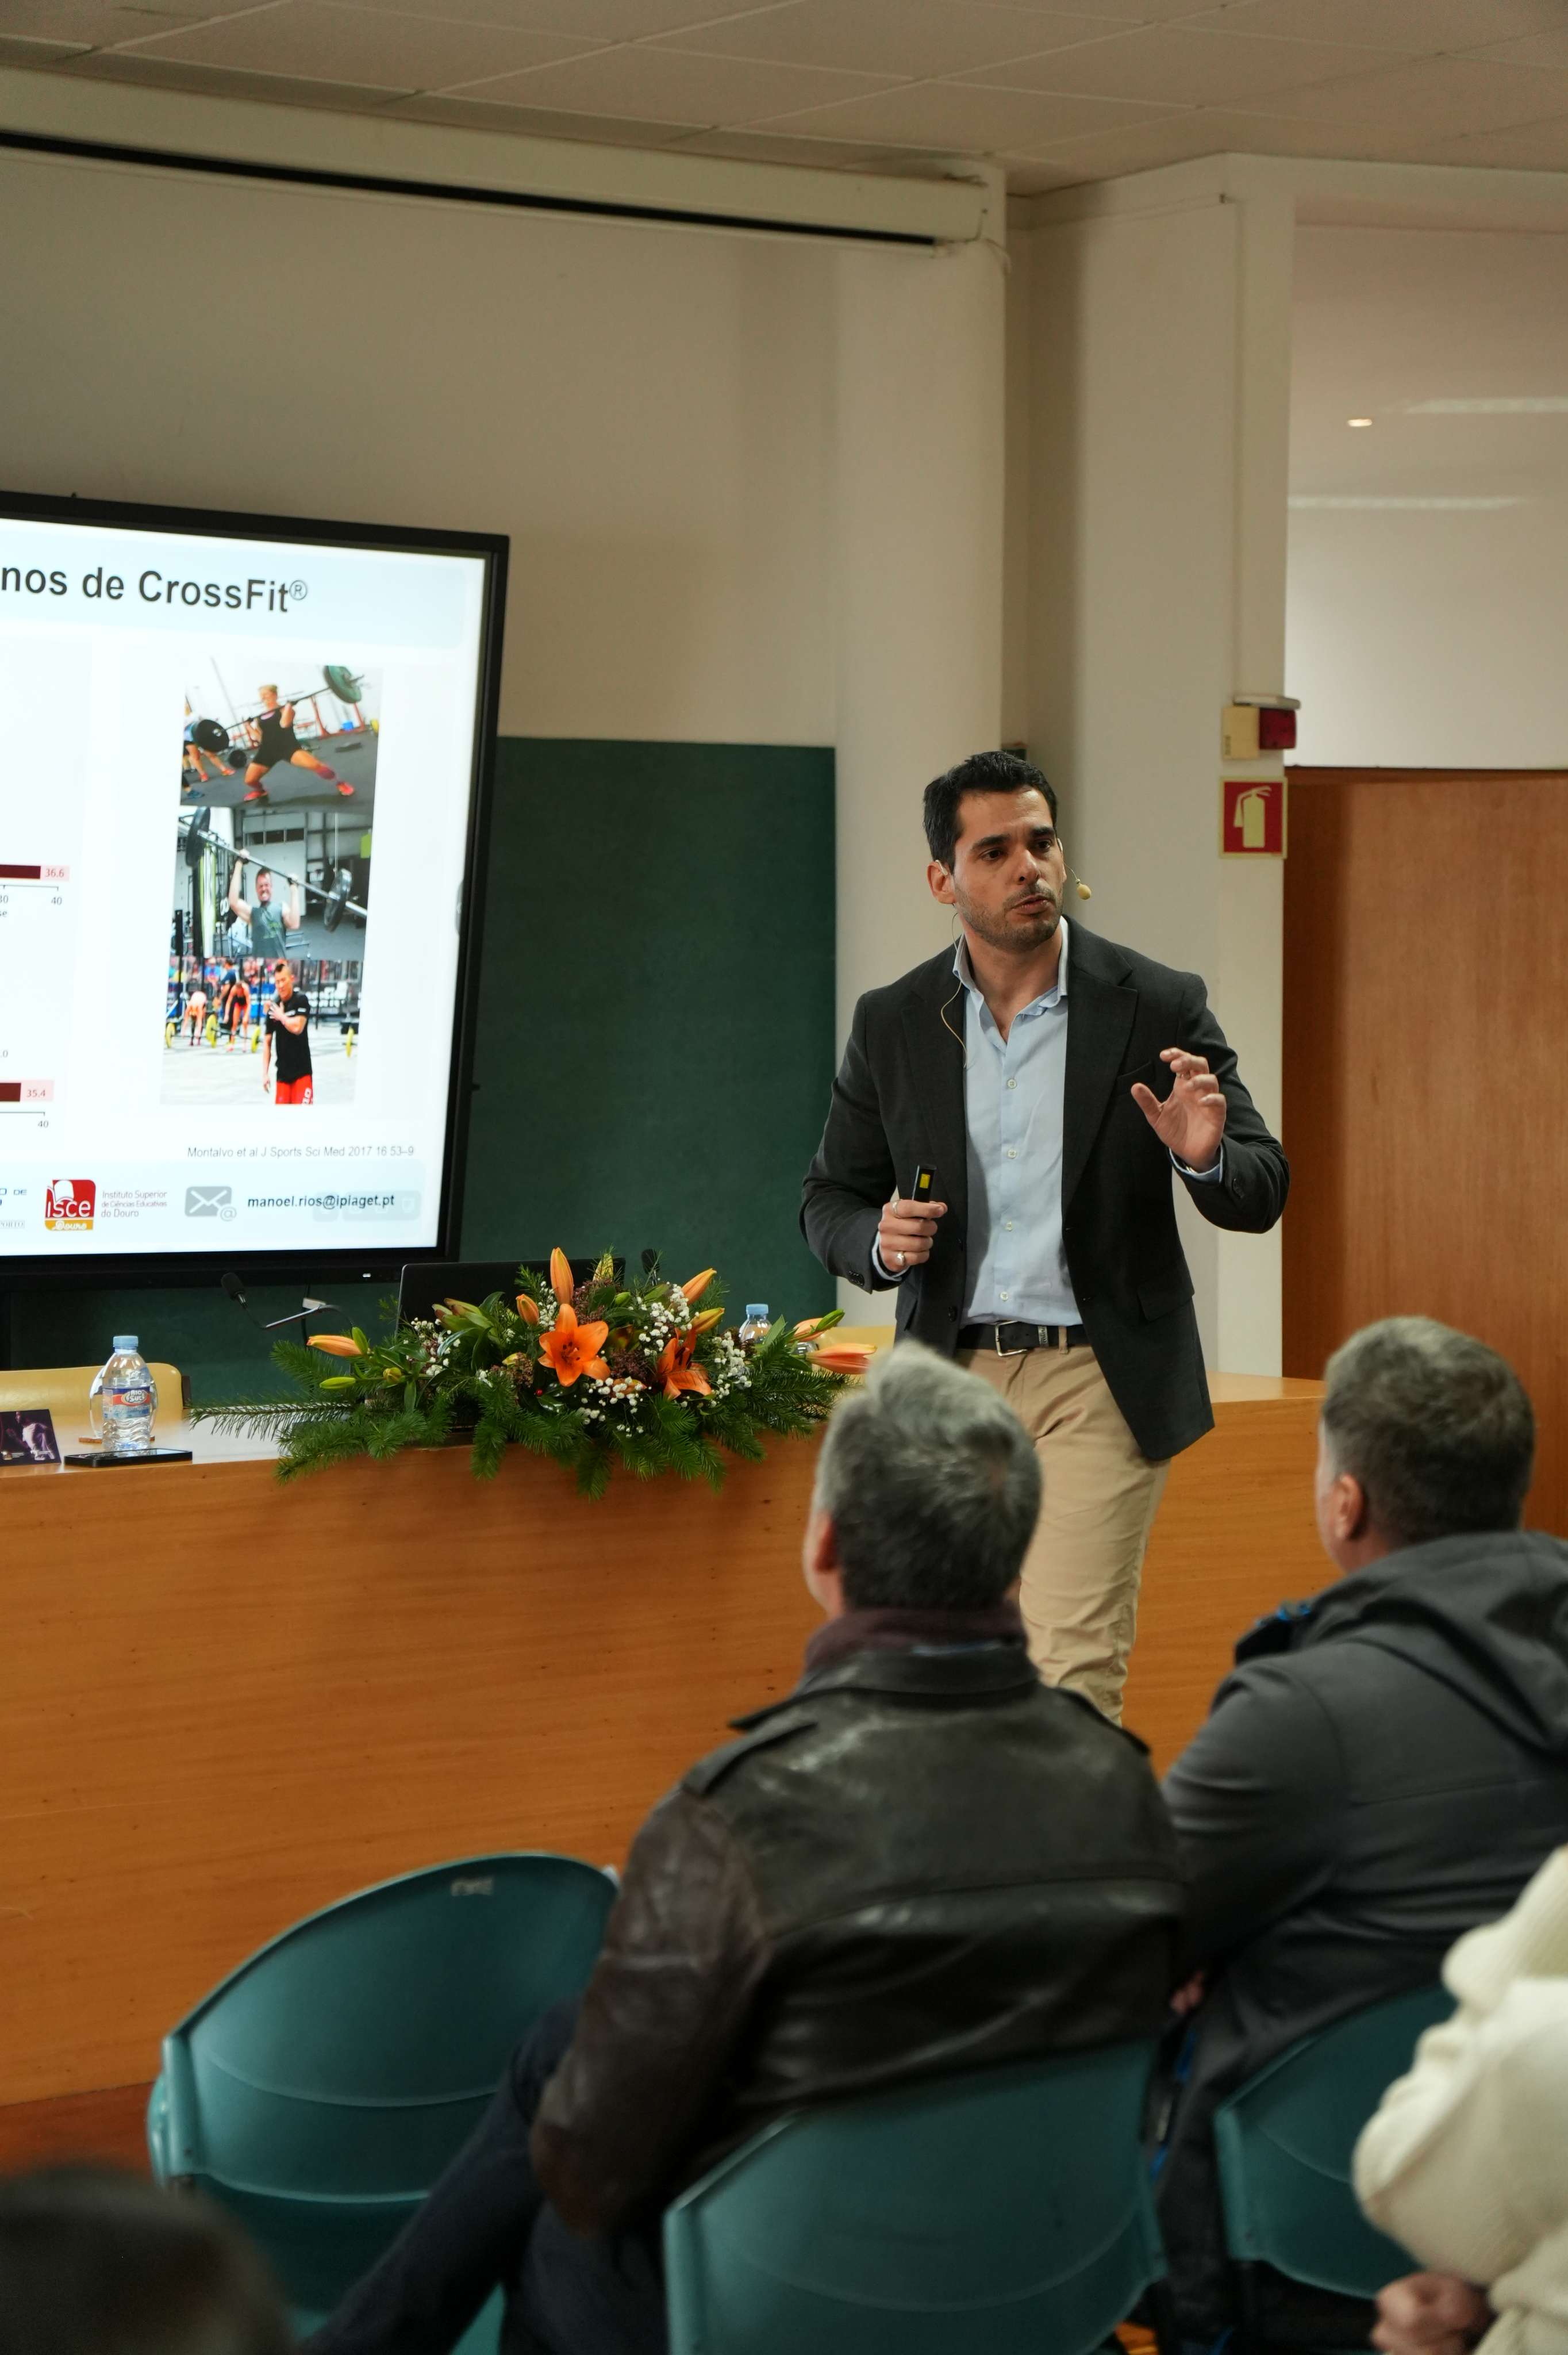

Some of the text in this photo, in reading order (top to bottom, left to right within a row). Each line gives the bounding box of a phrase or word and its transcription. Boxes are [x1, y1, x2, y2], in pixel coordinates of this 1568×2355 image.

[2, 567, 67, 595] nos
[83, 567, 124, 599] de
[45, 868, 65, 878] 36.6
[51, 896, 63, 905] 40
[27, 1090, 46, 1098] 35.4
[187, 1147, 233, 1157] Montalvo
[237, 1148, 246, 1157] et
[261, 1147, 267, 1157] J
[270, 1146, 302, 1159] Sports
[305, 1146, 320, 1157] Sci
[324, 1146, 345, 1157] Med
[348, 1146, 372, 1156] 2017
[376, 1146, 387, 1156] 16
[102, 1190, 167, 1200] Instituto Superior
[248, 1195, 394, 1210] manoel.rios@ipiaget.pt
[101, 1209, 139, 1218] do Douro
